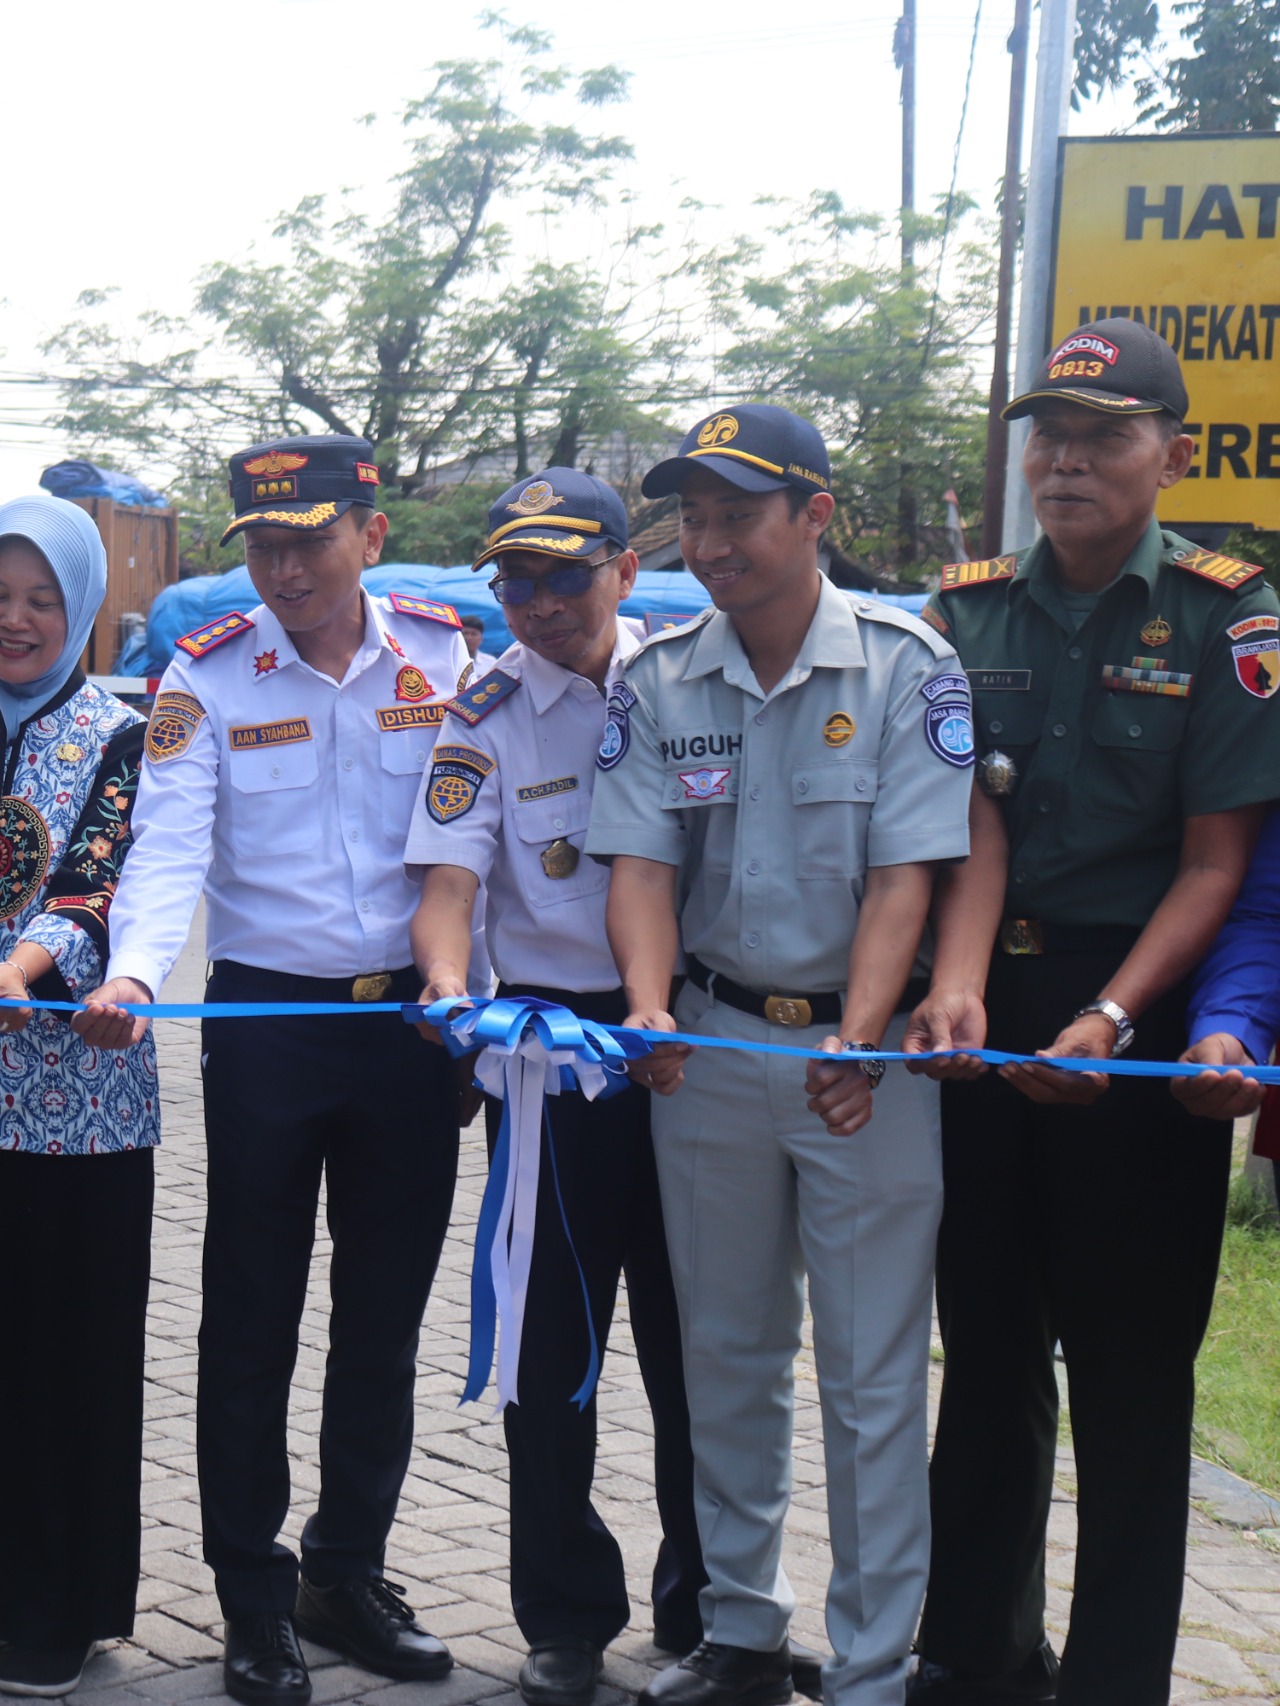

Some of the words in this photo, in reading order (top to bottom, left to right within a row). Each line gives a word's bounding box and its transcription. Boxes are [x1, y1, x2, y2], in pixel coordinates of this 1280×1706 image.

[1052, 337, 1114, 363] KODIM
[1048, 361, 1104, 380] 0813
[1226, 566, 1255, 583] TNI
[1231, 619, 1258, 637] KODIM
[1234, 641, 1279, 657] BRAWIJAYA
[926, 679, 955, 696] CABANG
[383, 706, 446, 726] DISHUB
[448, 700, 480, 721] DISHUB
[235, 730, 257, 745] AAN
[259, 722, 308, 743] SYAHBANA
[660, 733, 742, 763] PUGUH
[459, 750, 491, 771] PROVINSI
